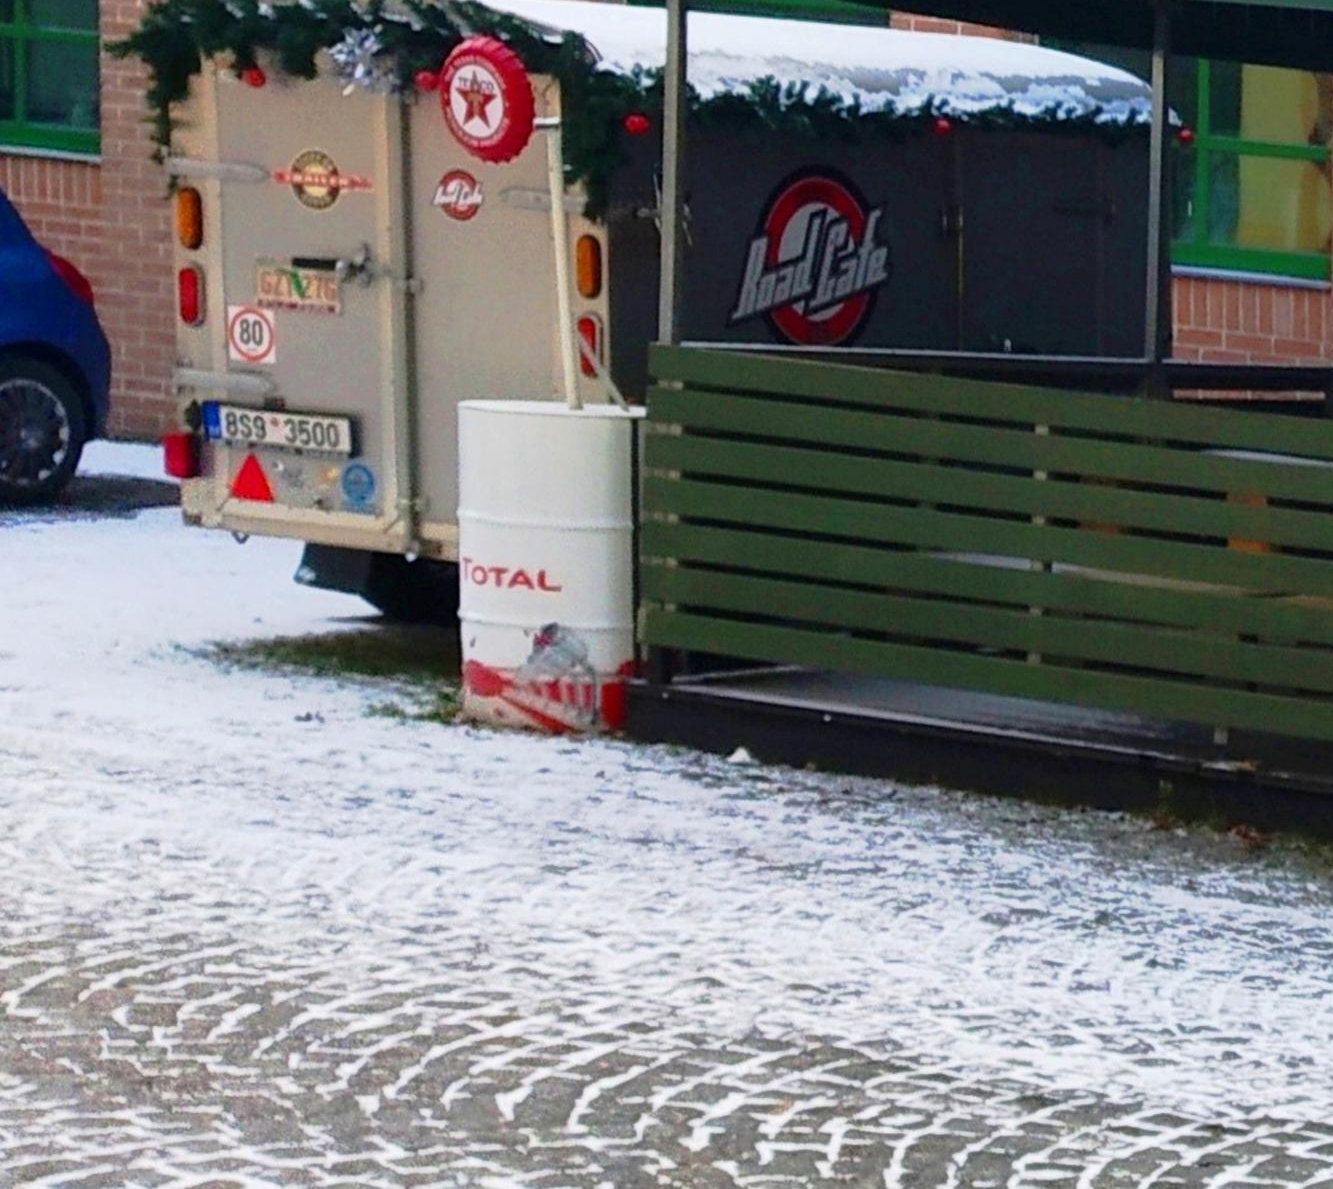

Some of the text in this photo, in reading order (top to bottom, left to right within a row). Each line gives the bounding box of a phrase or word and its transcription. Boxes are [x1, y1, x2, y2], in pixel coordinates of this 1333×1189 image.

[239, 317, 264, 347] 80
[225, 411, 340, 448] 8S9 3500
[462, 557, 562, 592] TOTAL
